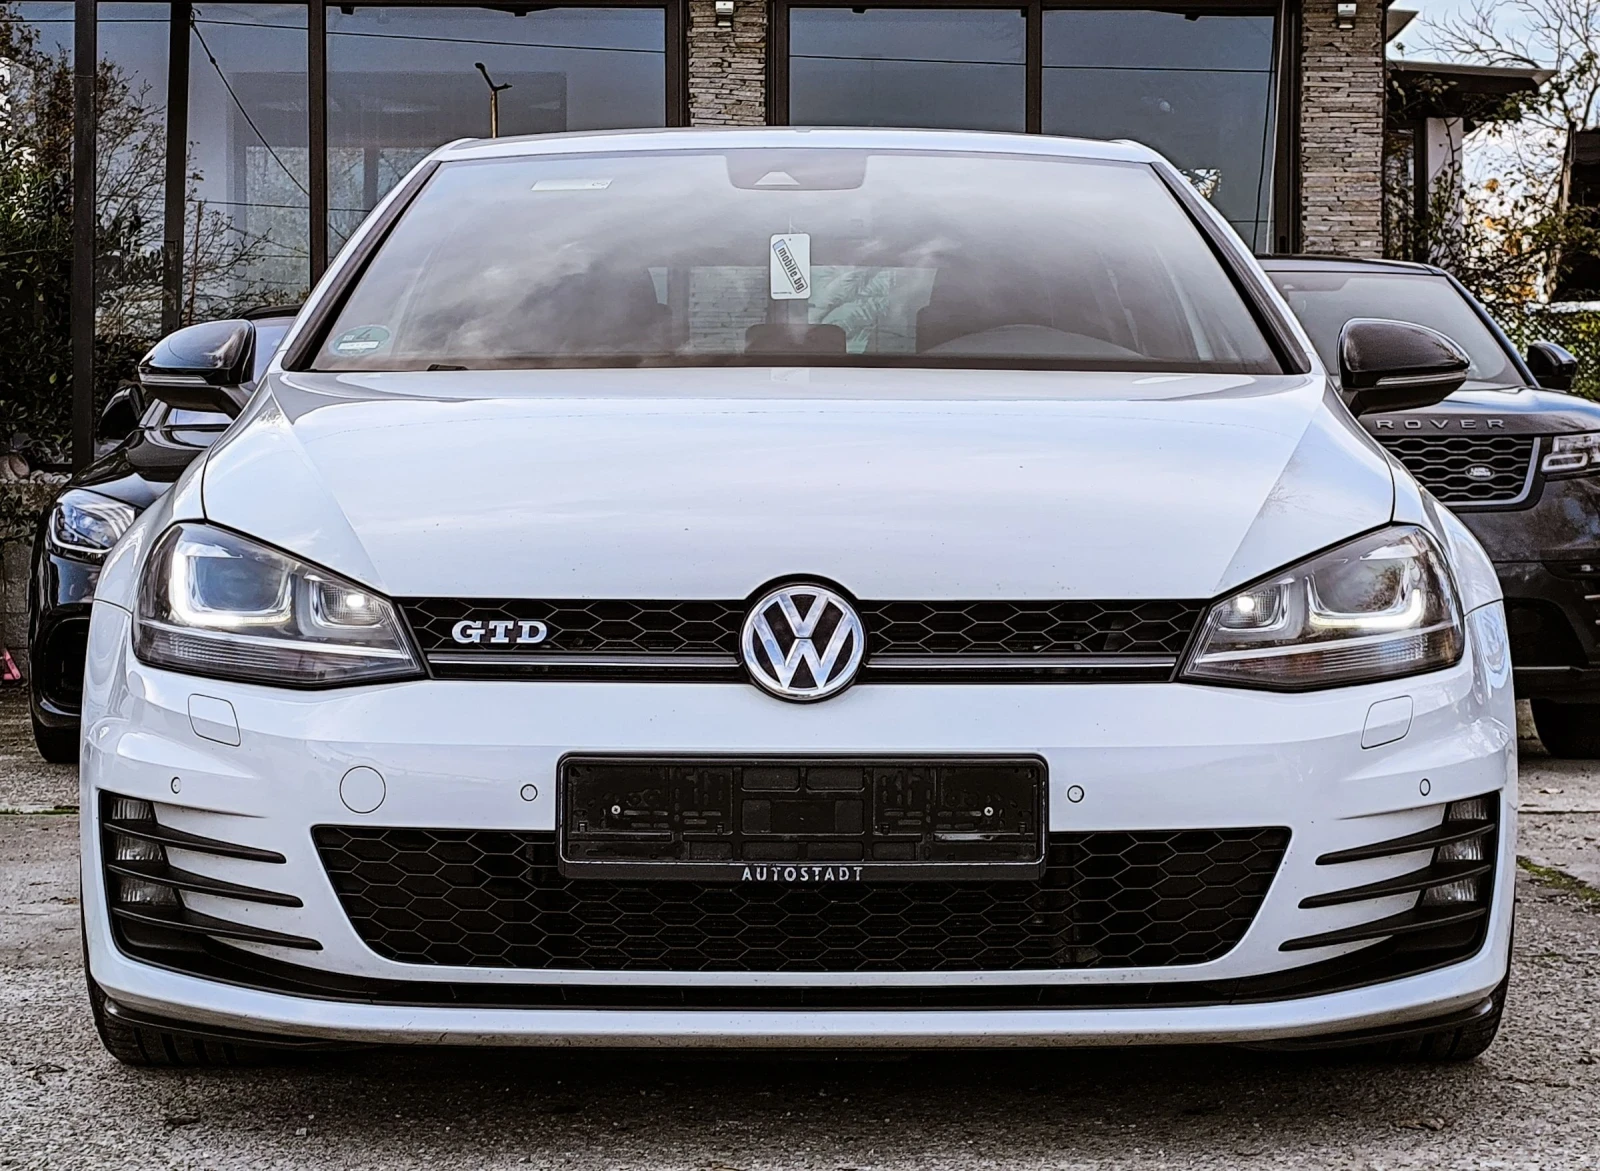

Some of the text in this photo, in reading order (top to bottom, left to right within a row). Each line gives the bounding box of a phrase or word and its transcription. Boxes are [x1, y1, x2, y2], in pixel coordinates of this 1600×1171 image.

[777, 247, 805, 291] mobile.bg
[1375, 418, 1506, 430] ROVER
[451, 619, 549, 645] GTD
[747, 591, 859, 692] VW
[741, 866, 863, 882] AUTOSTADT
